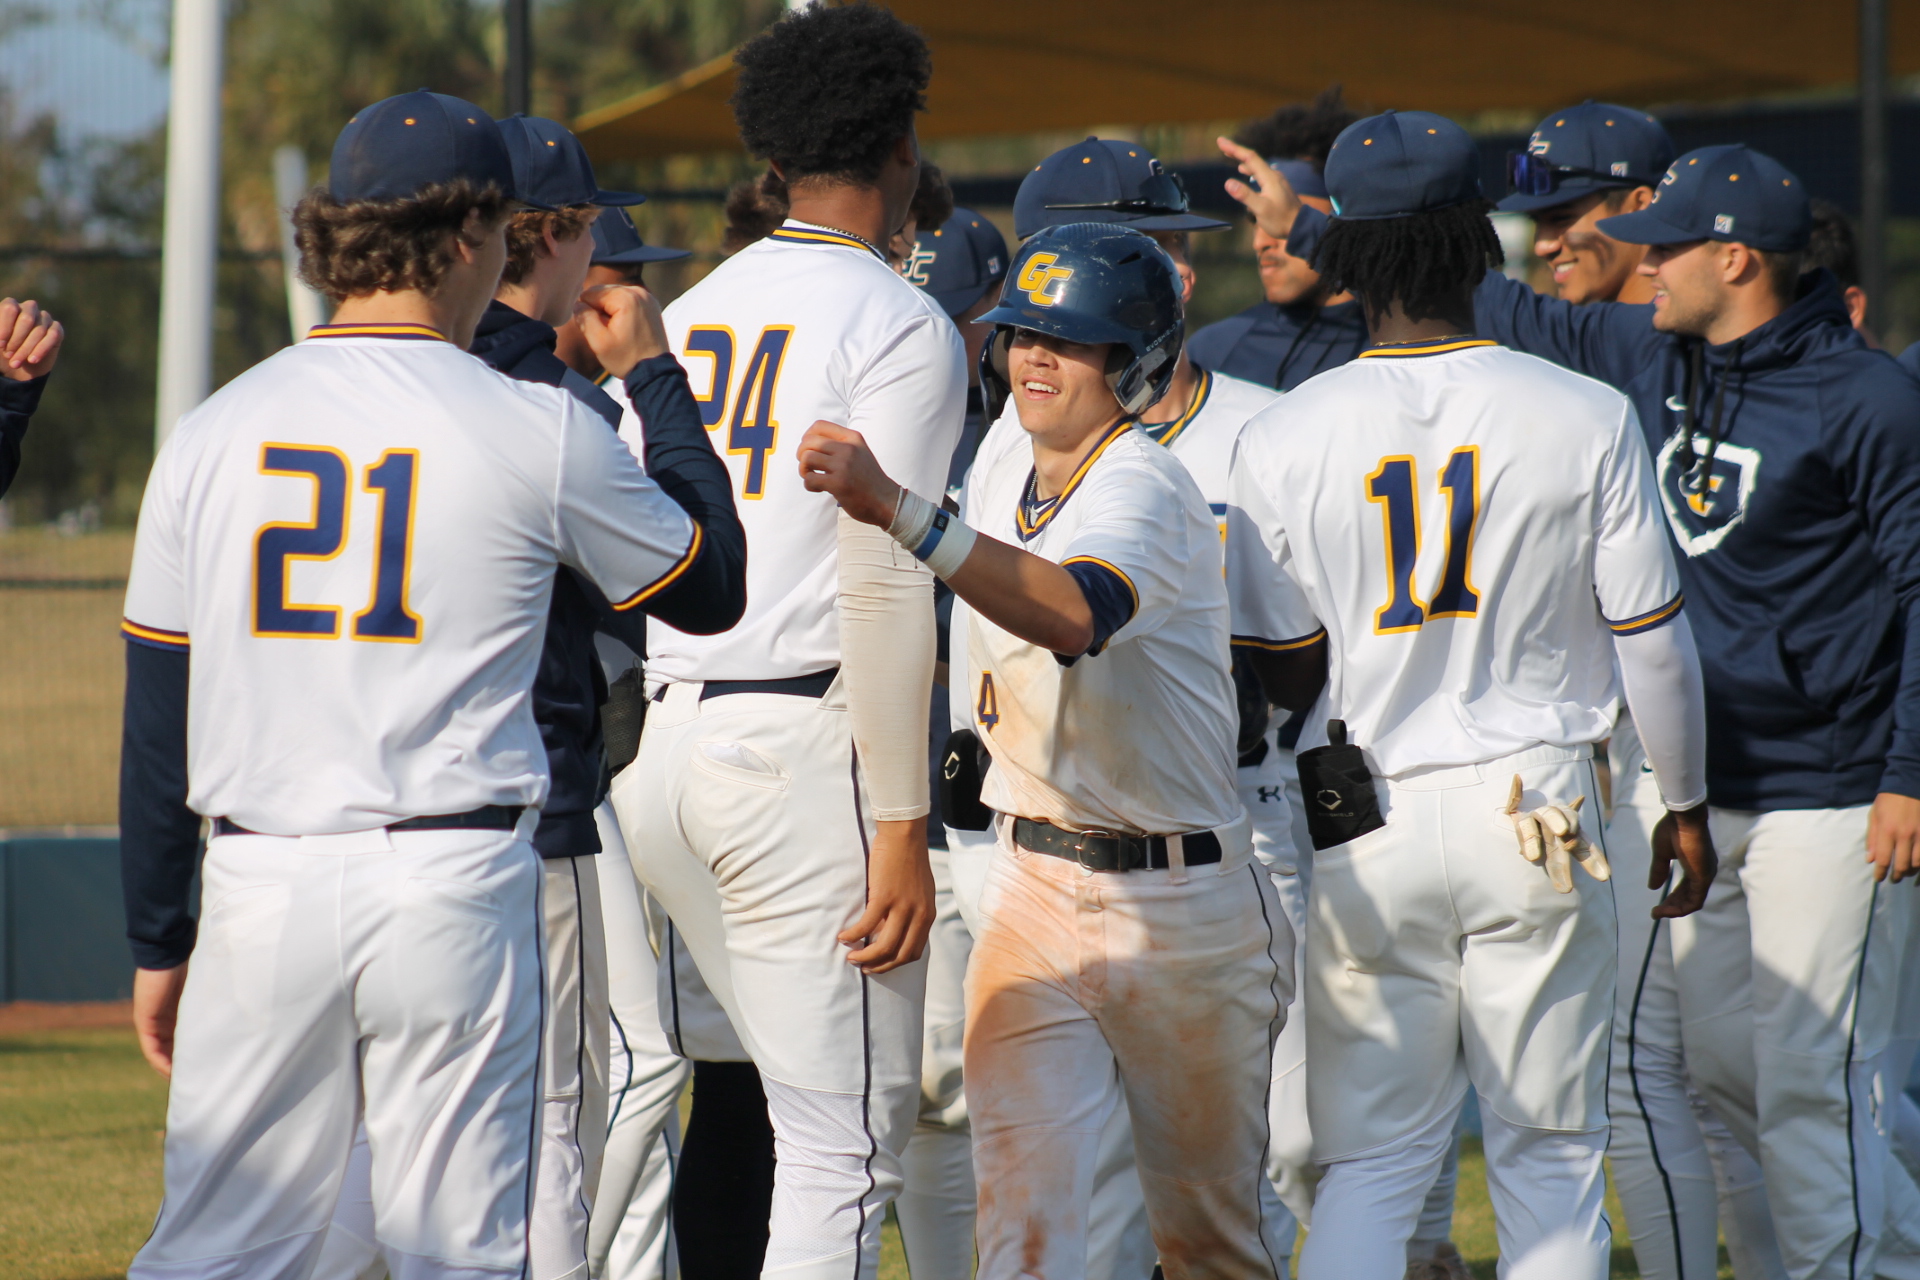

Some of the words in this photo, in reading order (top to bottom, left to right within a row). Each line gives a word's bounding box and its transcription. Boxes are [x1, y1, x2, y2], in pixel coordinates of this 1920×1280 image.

[1016, 251, 1075, 307] GC
[251, 441, 424, 645] 21
[1363, 444, 1481, 636] 11
[977, 670, 1000, 733] 4
